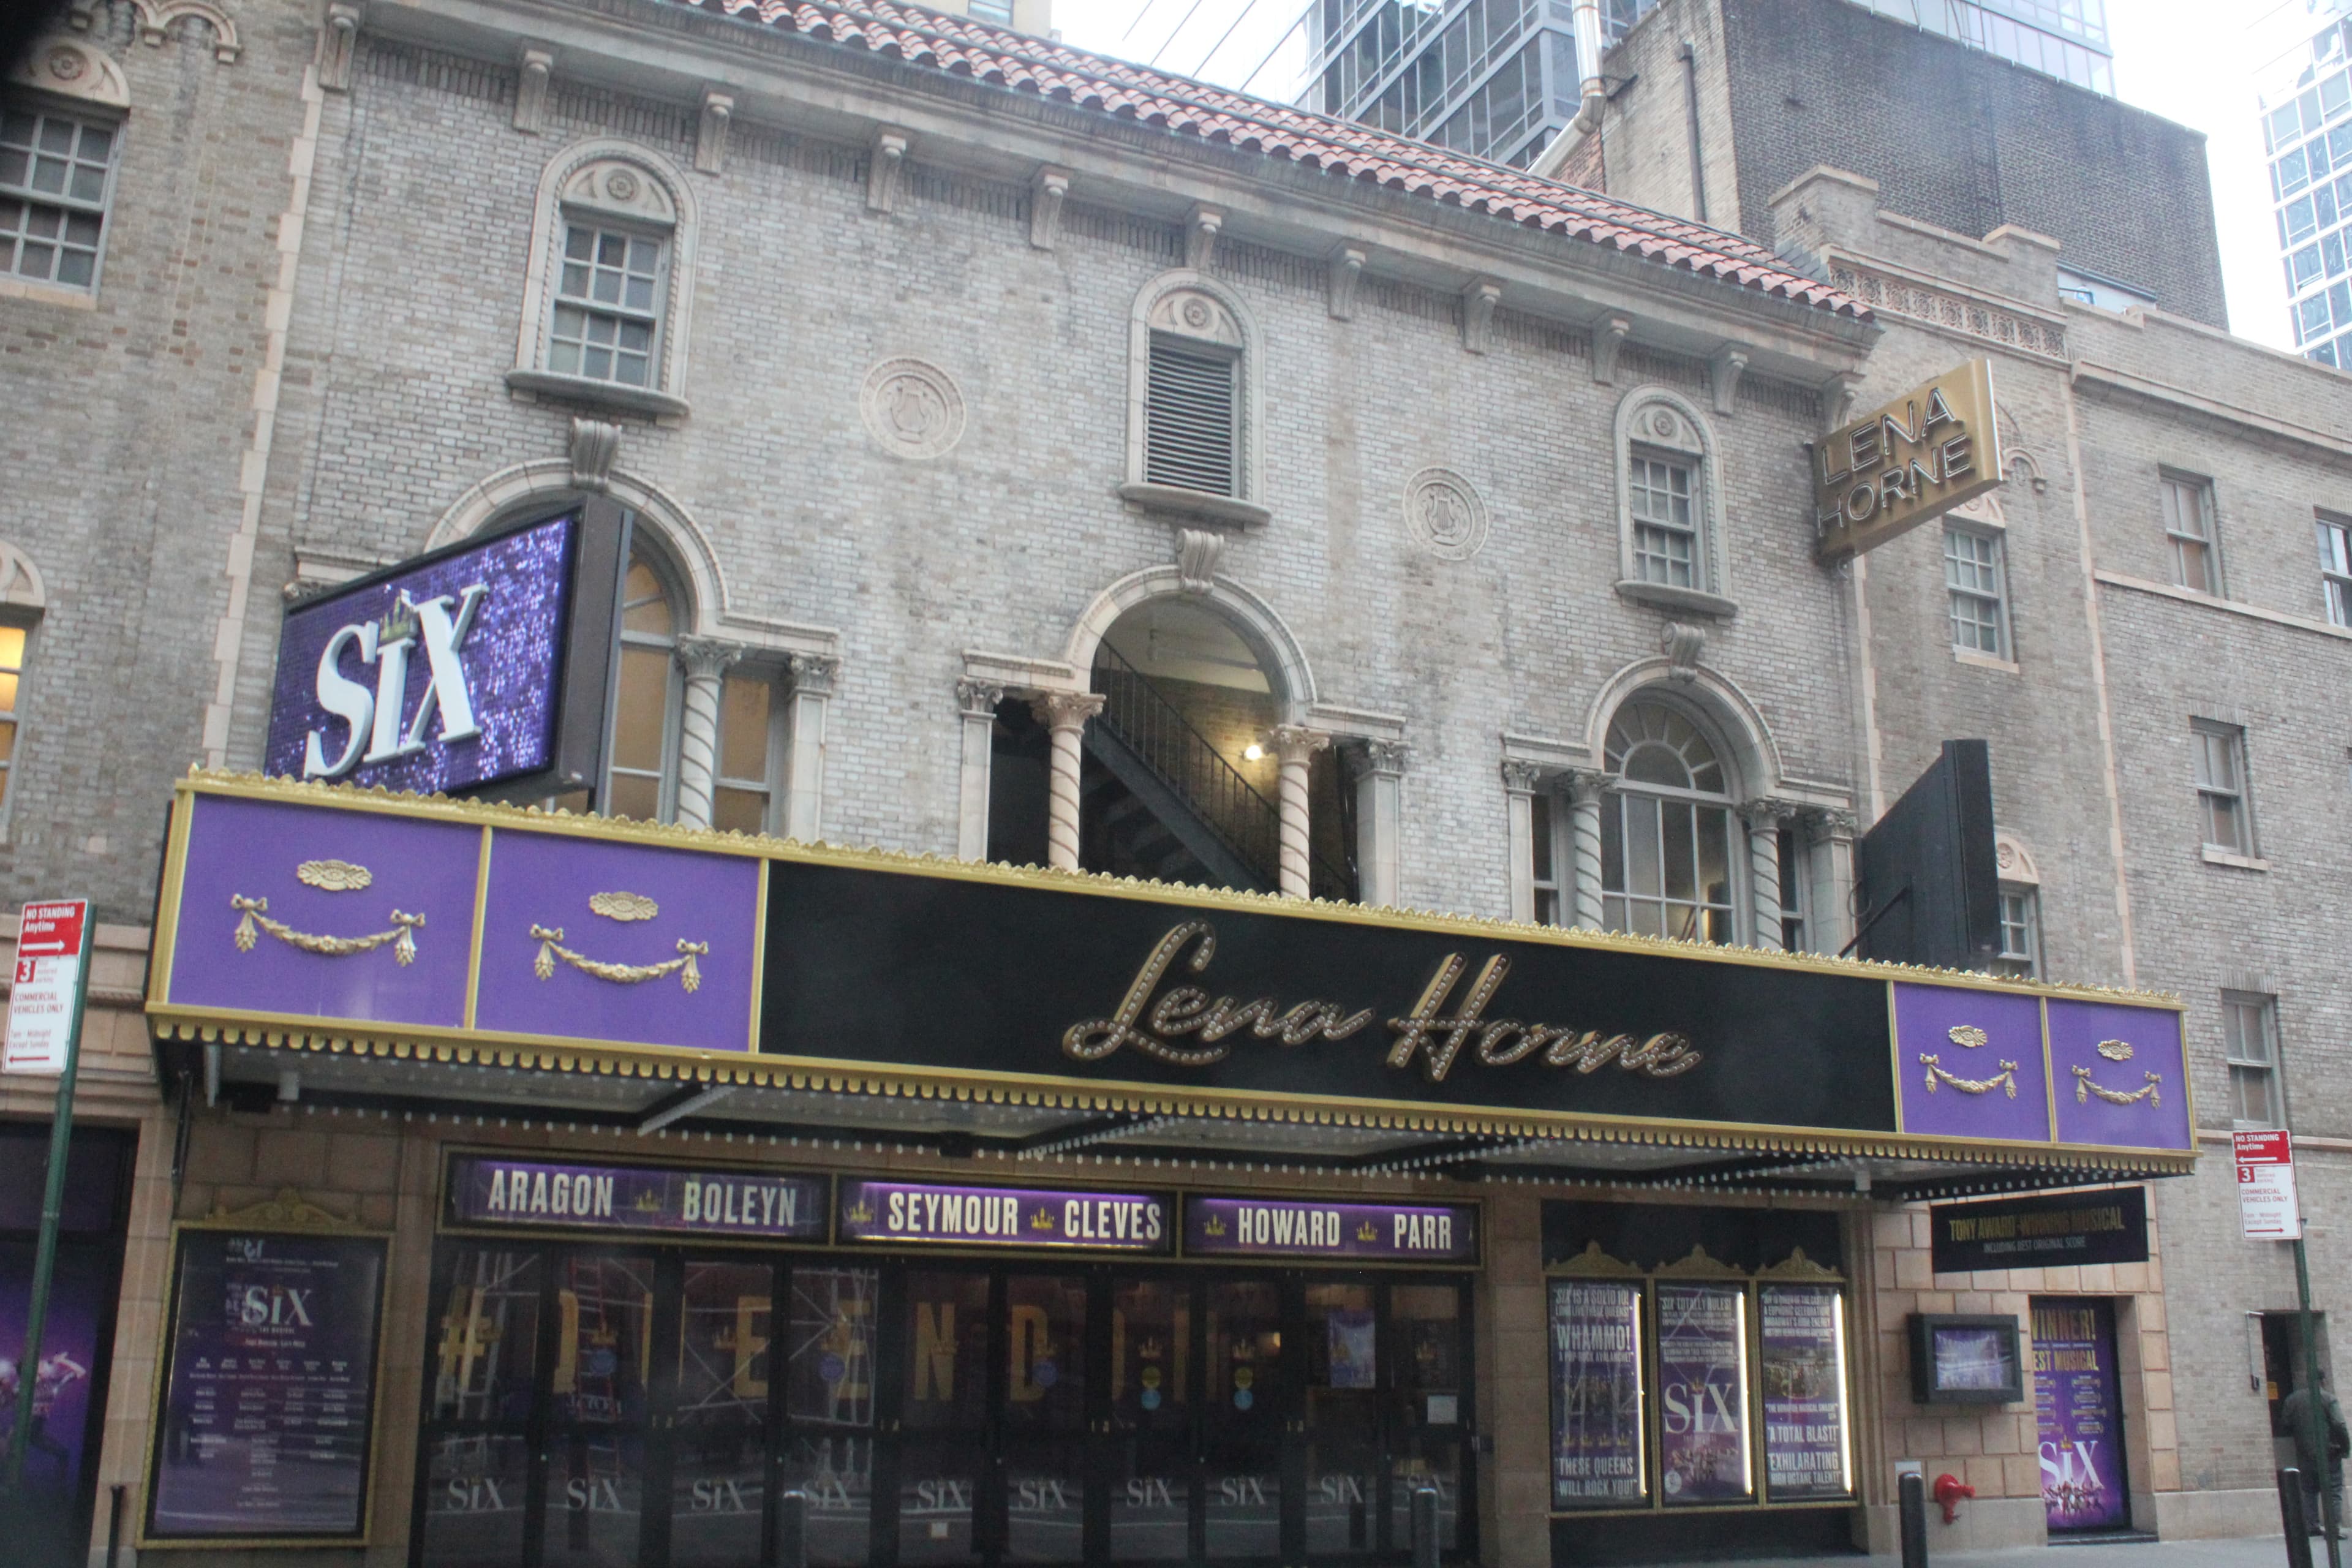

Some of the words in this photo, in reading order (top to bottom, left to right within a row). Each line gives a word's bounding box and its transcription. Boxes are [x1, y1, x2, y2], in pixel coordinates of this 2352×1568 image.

[1822, 387, 1956, 485] LENA
[1817, 433, 1972, 537] HORNE
[303, 583, 489, 779] SIX
[25, 921, 56, 934] Anytime
[26, 907, 37, 919] NO
[39, 906, 75, 919] STANDING
[20, 958, 32, 981] 3
[13, 1005, 45, 1014] VEHICLES
[15, 992, 58, 1001] COMMERCIAL
[1062, 917, 1376, 1066] Lena
[1387, 952, 1704, 1084] Horne
[2241, 1167, 2251, 1182] 3
[488, 1169, 614, 1217] ARAGON
[683, 1180, 797, 1227] BOLEYN
[889, 1191, 1019, 1236] SEYMOUR
[1065, 1199, 1161, 1241] CLEVES
[1238, 1207, 1341, 1248] HOWARD
[1949, 1218, 1977, 1242] TONY
[2070, 1205, 2126, 1234] MUSICAL
[1393, 1213, 1452, 1251] PARR
[1983, 1240, 2016, 1254] INCLUDING
[2017, 1239, 2033, 1252] BEST
[2034, 1237, 2064, 1251] ORIGINAL
[2065, 1235, 2086, 1248] SCORE
[241, 1284, 313, 1327] SIX
[1591, 1289, 1616, 1305] SOLID
[1676, 1297, 1706, 1311] TOTALLY
[1707, 1297, 1732, 1311] RULES!
[2054, 1349, 2100, 1372] MUSICAL
[1664, 1382, 1739, 1434] SIX
[1777, 1425, 1805, 1443] TOTAL
[1594, 1457, 1634, 1478] QUEENS
[2038, 1441, 2106, 1490] SIX
[447, 1477, 505, 1510] SIX
[566, 1476, 622, 1510] SIX
[691, 1478, 745, 1510] SIX
[917, 1479, 968, 1510] SIX
[1019, 1479, 1068, 1510] SIX
[1126, 1476, 1174, 1509] SIX
[1221, 1475, 1266, 1506] SIX
[1321, 1474, 1363, 1504] SIX
[1559, 1479, 1581, 1496] WILL
[1585, 1479, 1609, 1496] ROCK
